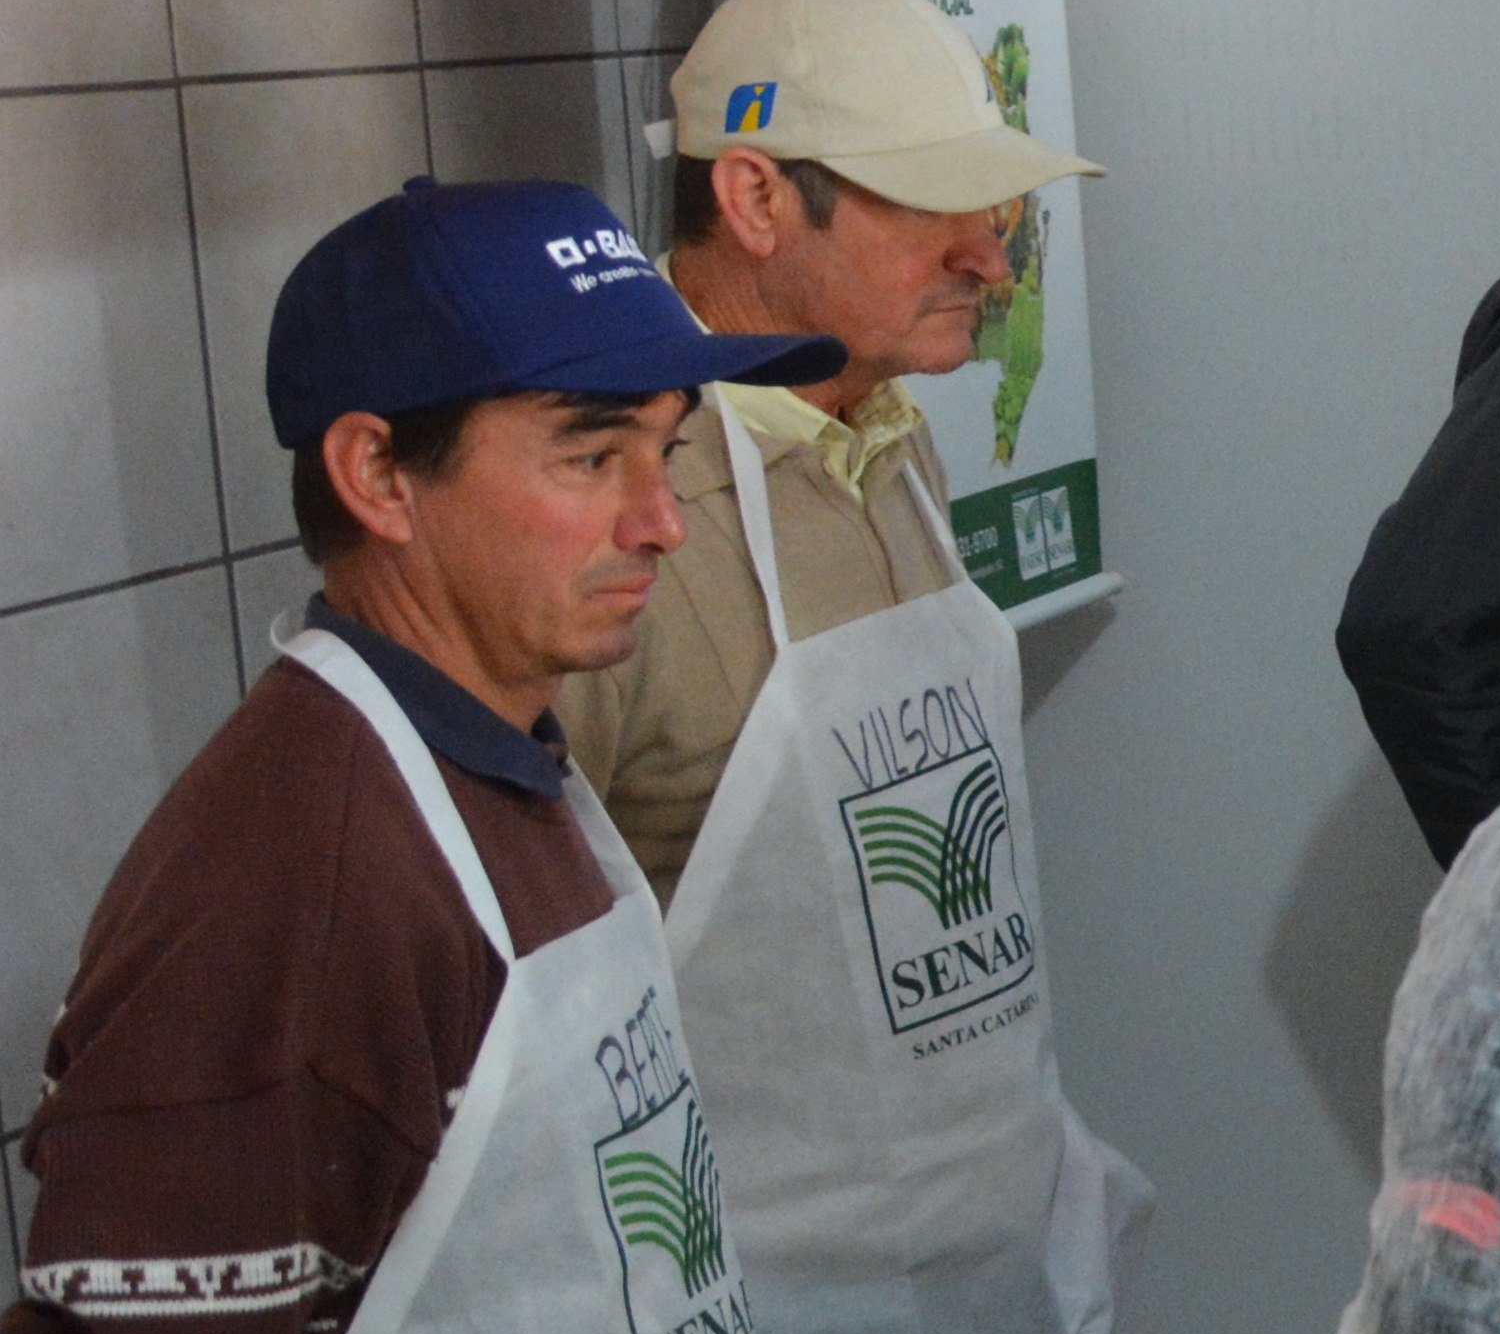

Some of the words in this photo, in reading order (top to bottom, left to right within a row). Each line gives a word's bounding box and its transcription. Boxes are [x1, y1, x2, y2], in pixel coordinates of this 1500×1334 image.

[570, 271, 598, 294] We
[832, 677, 990, 791] VILSON
[891, 911, 1032, 1012] SENAR
[912, 1024, 978, 1061] SANTA
